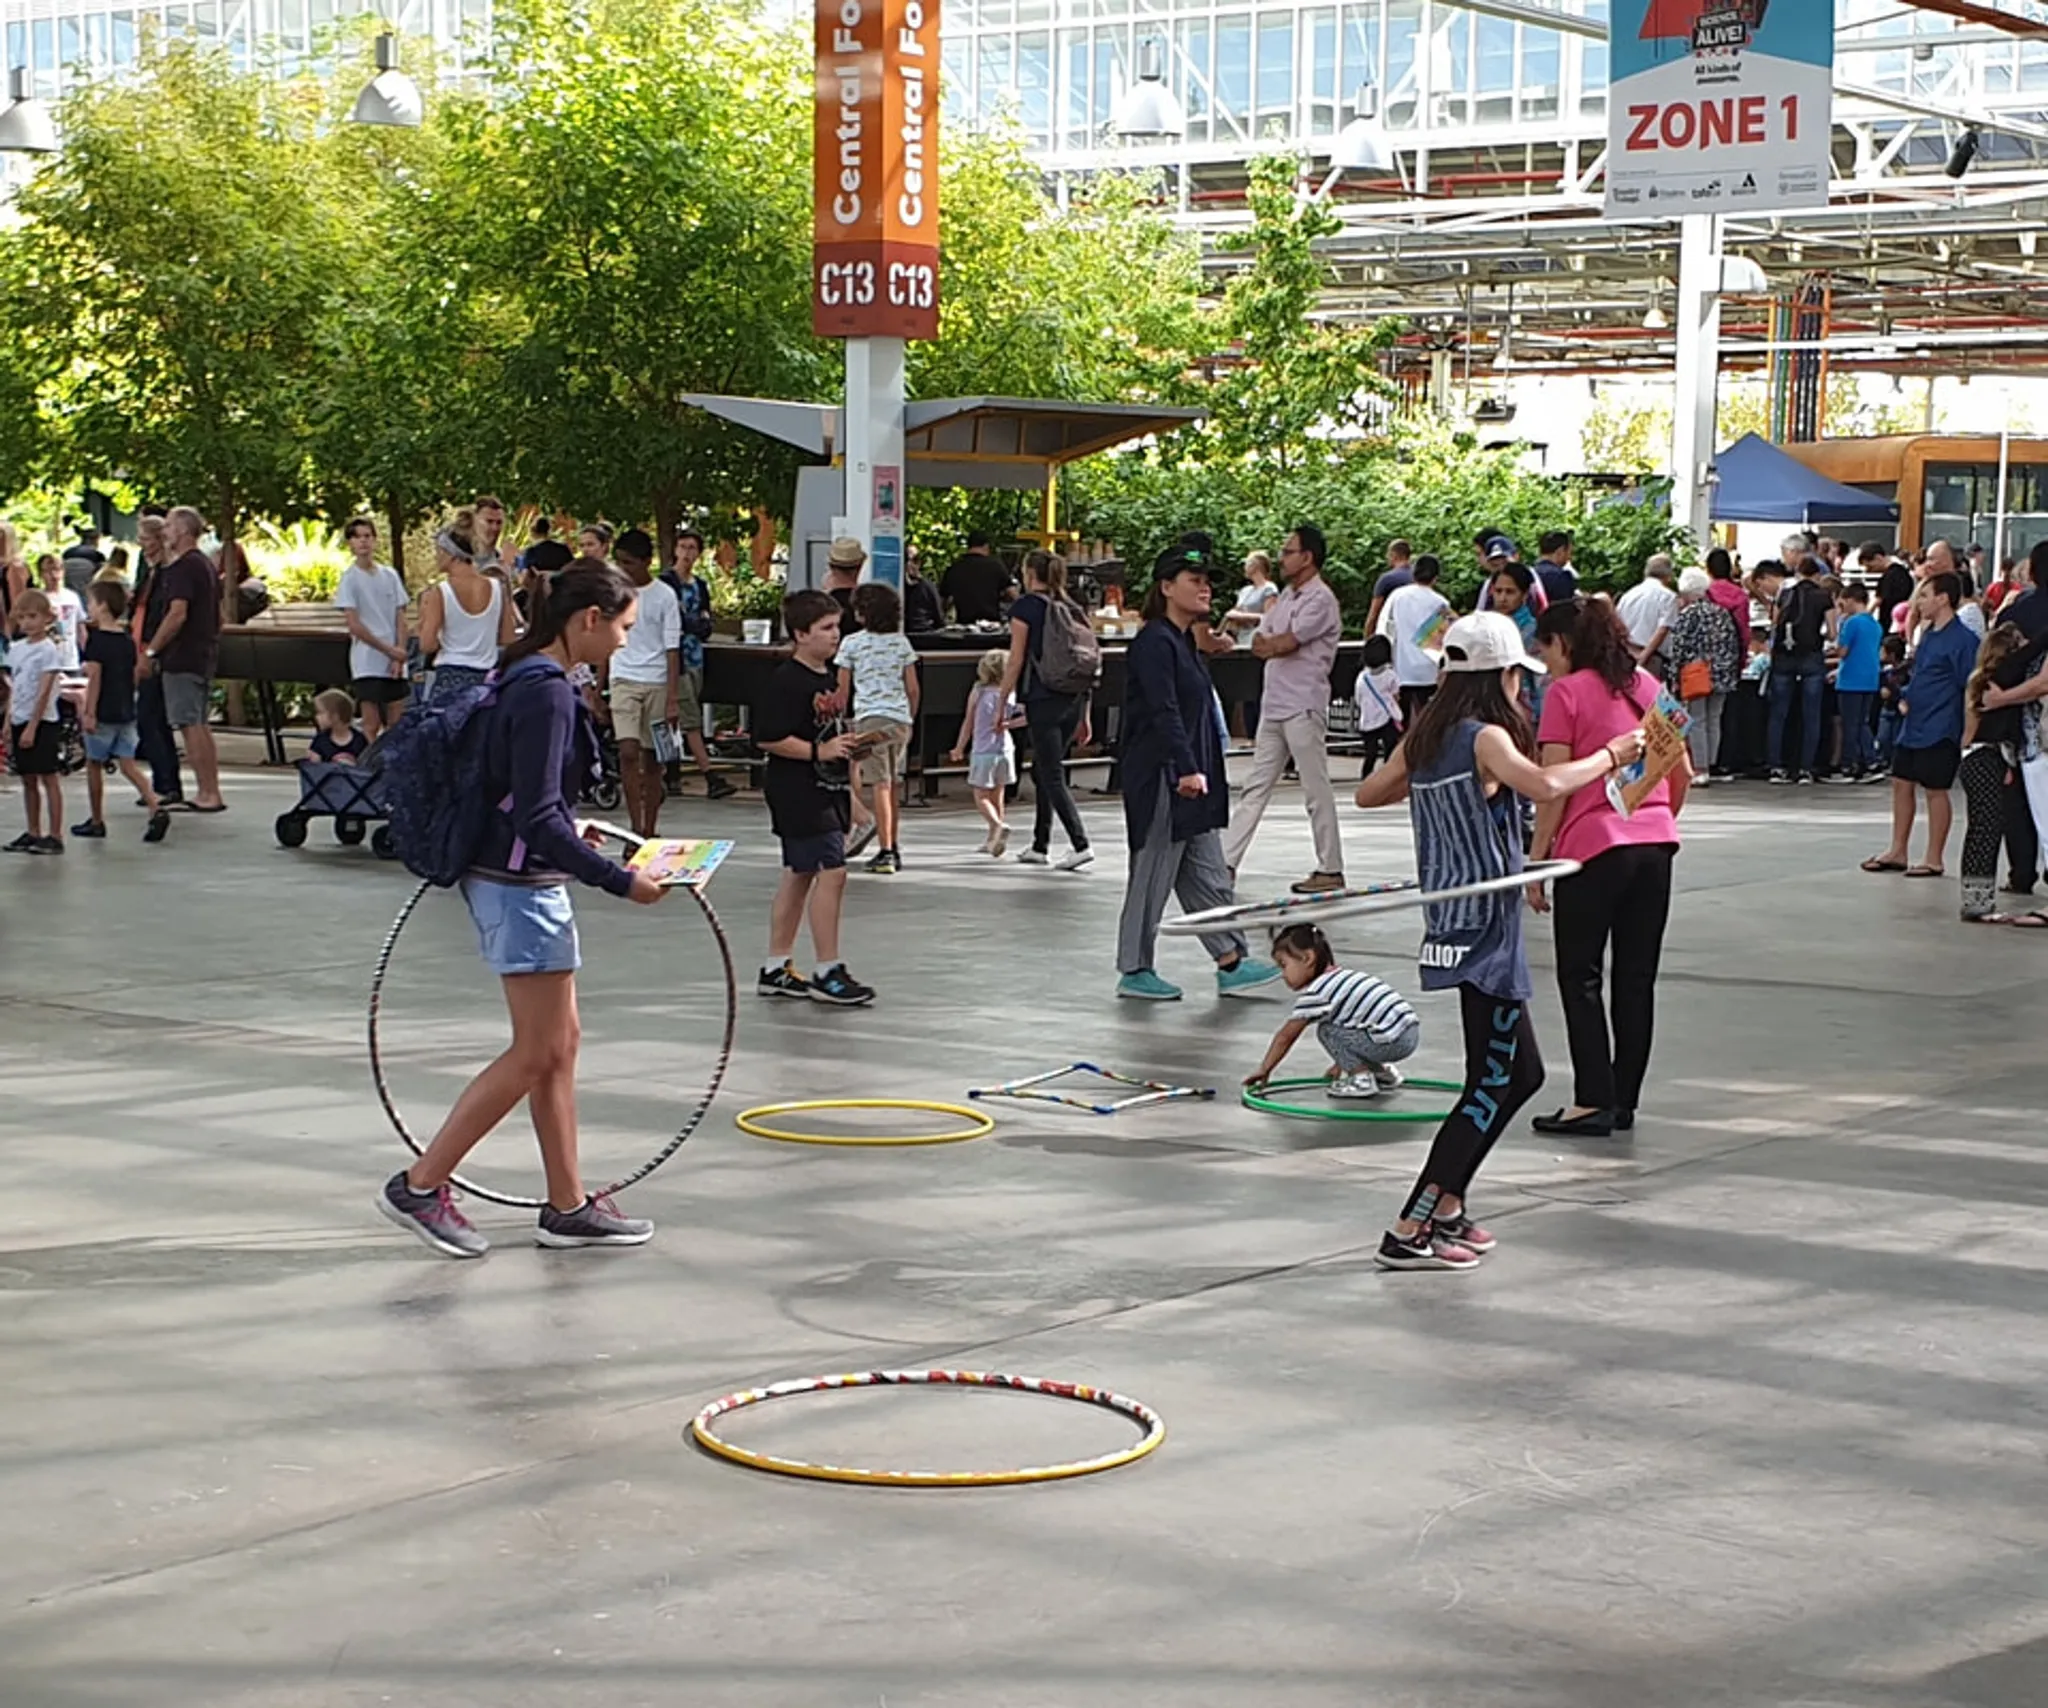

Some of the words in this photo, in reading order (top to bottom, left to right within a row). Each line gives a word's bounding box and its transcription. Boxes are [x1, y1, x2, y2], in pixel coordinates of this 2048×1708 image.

[833, 0, 863, 53] Fo
[899, 0, 925, 56] Fo
[1695, 24, 1743, 46] ALIVE!
[833, 66, 862, 225] Central
[899, 66, 924, 226] Central
[1625, 96, 1766, 151] ZONE
[1780, 94, 1798, 141] 1
[820, 262, 874, 305] C13
[889, 263, 934, 308] C13
[1461, 1004, 1520, 1135] STAR
